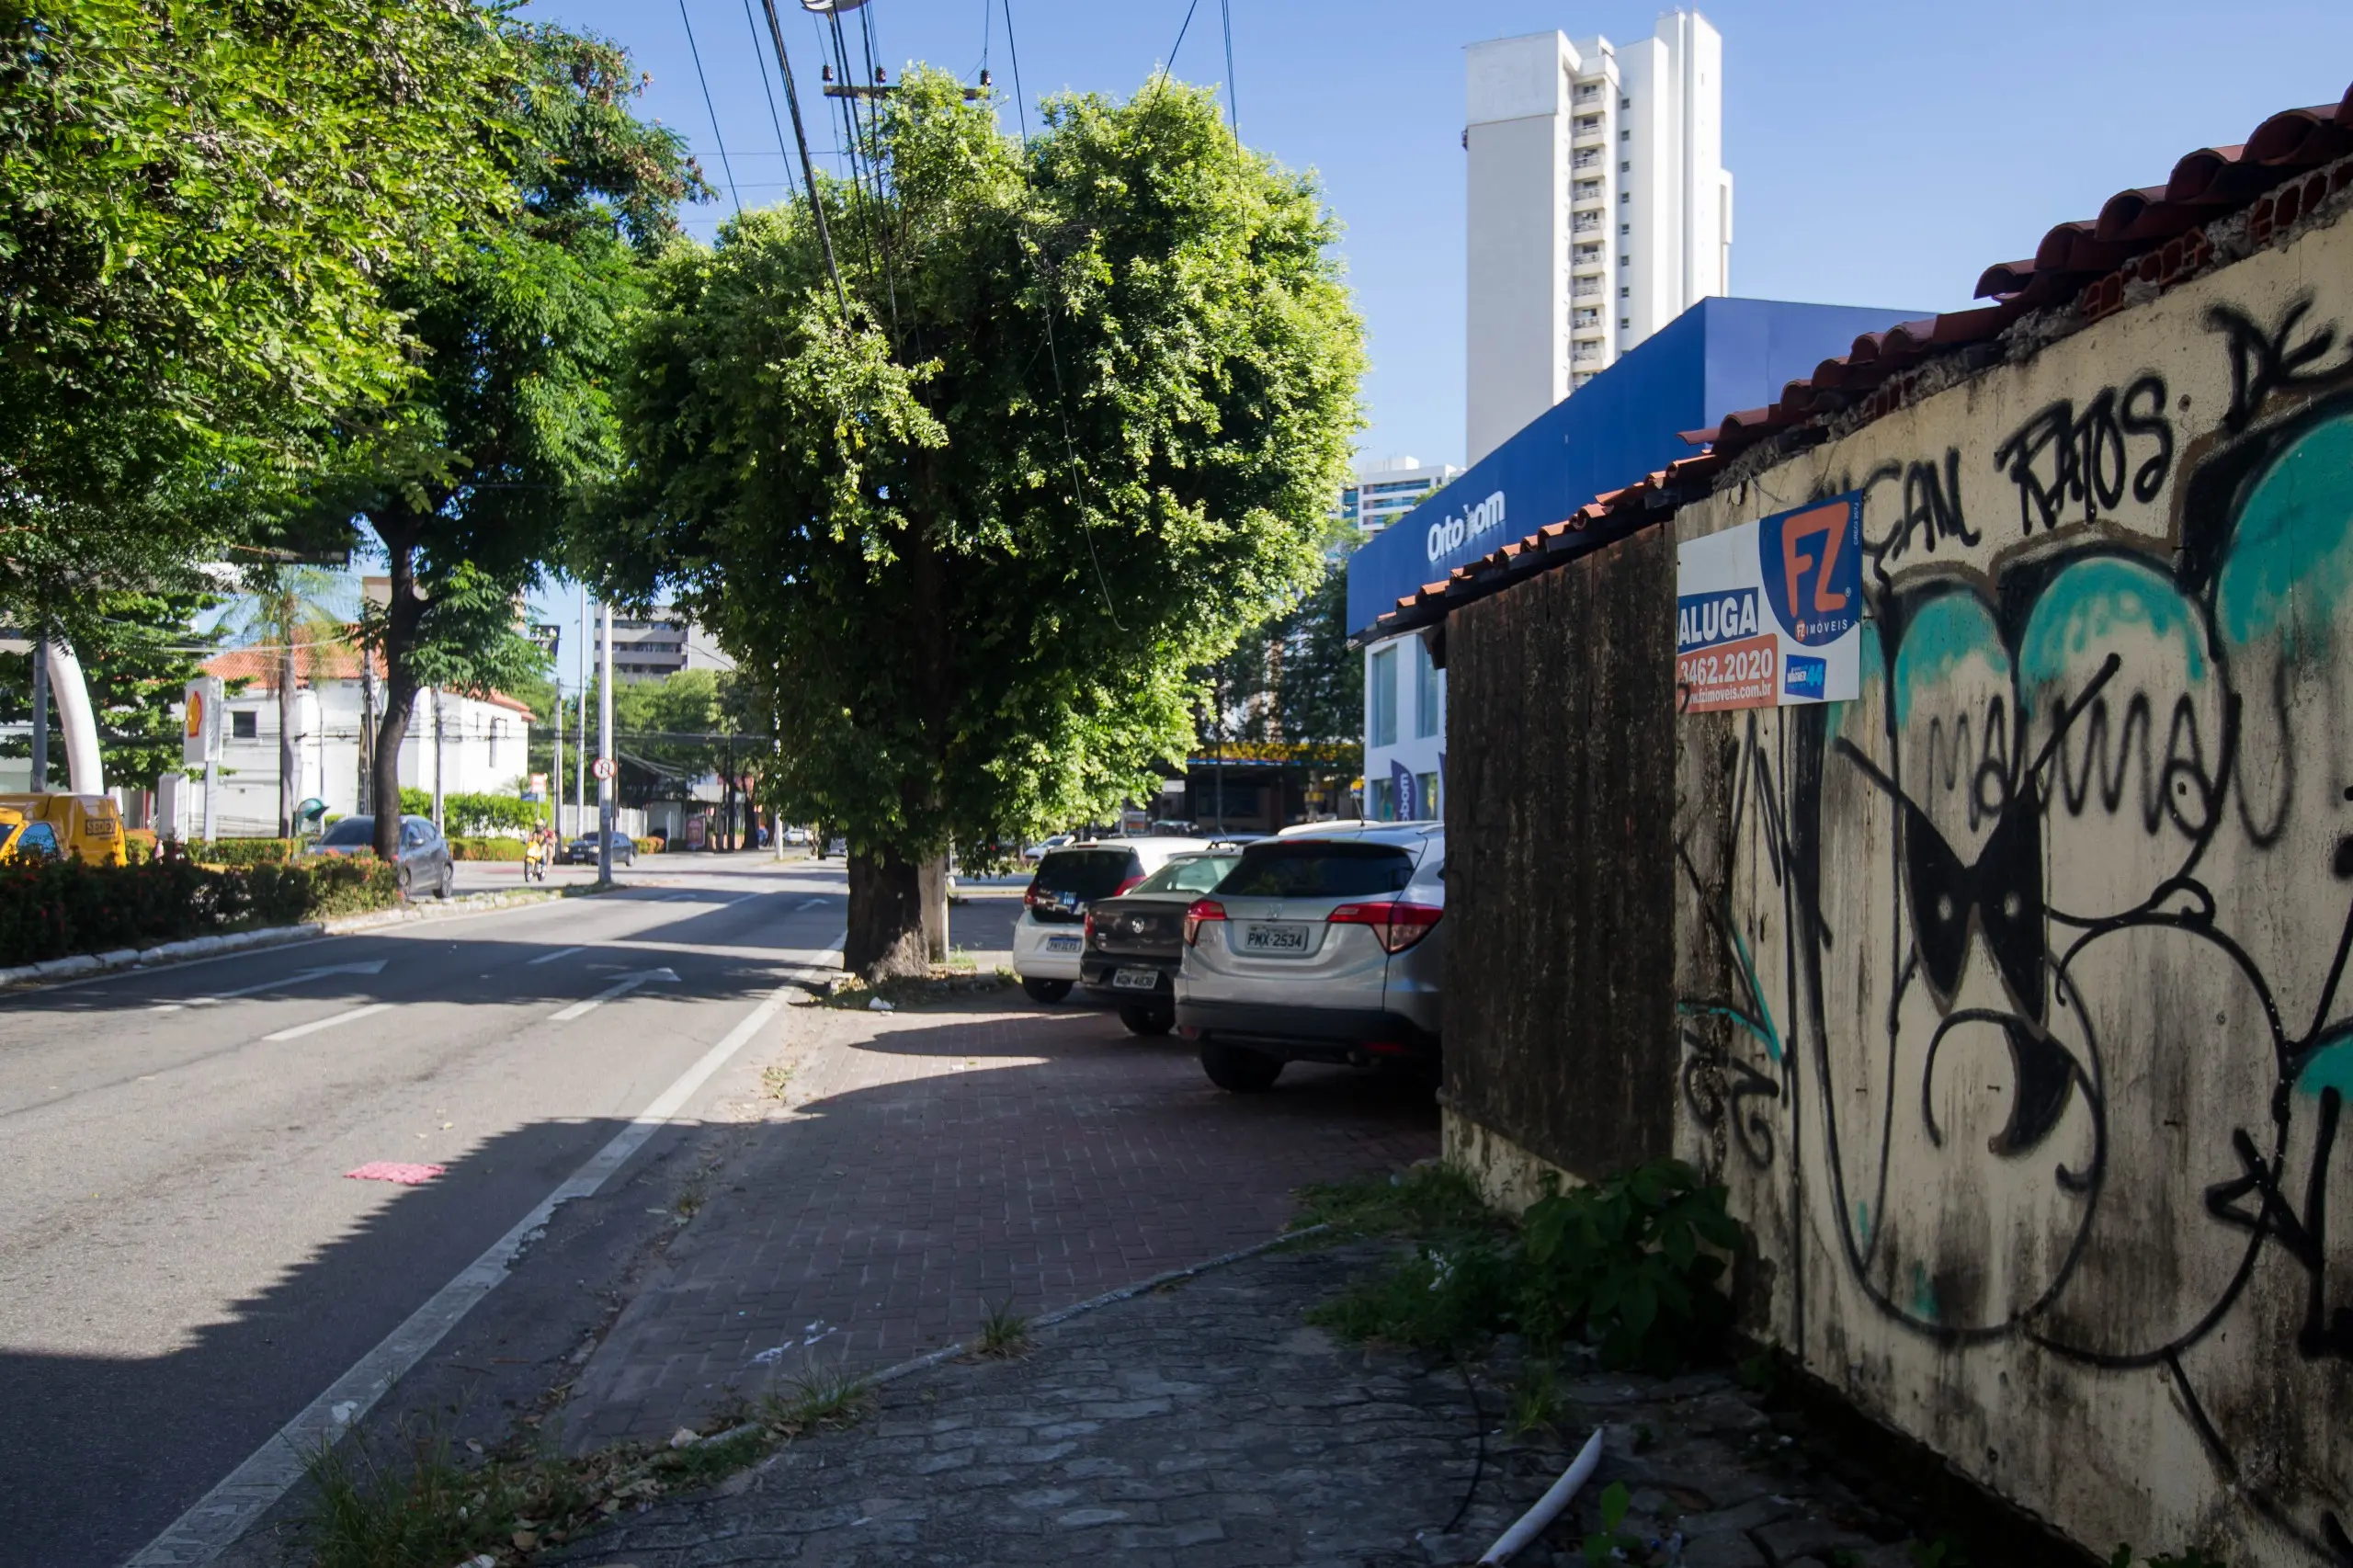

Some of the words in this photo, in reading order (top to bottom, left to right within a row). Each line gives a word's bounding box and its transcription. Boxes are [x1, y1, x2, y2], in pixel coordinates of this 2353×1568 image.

[1781, 501, 1850, 618] FZ
[1678, 594, 1757, 646] ALUGA
[1680, 648, 1773, 687] 3462.2020
